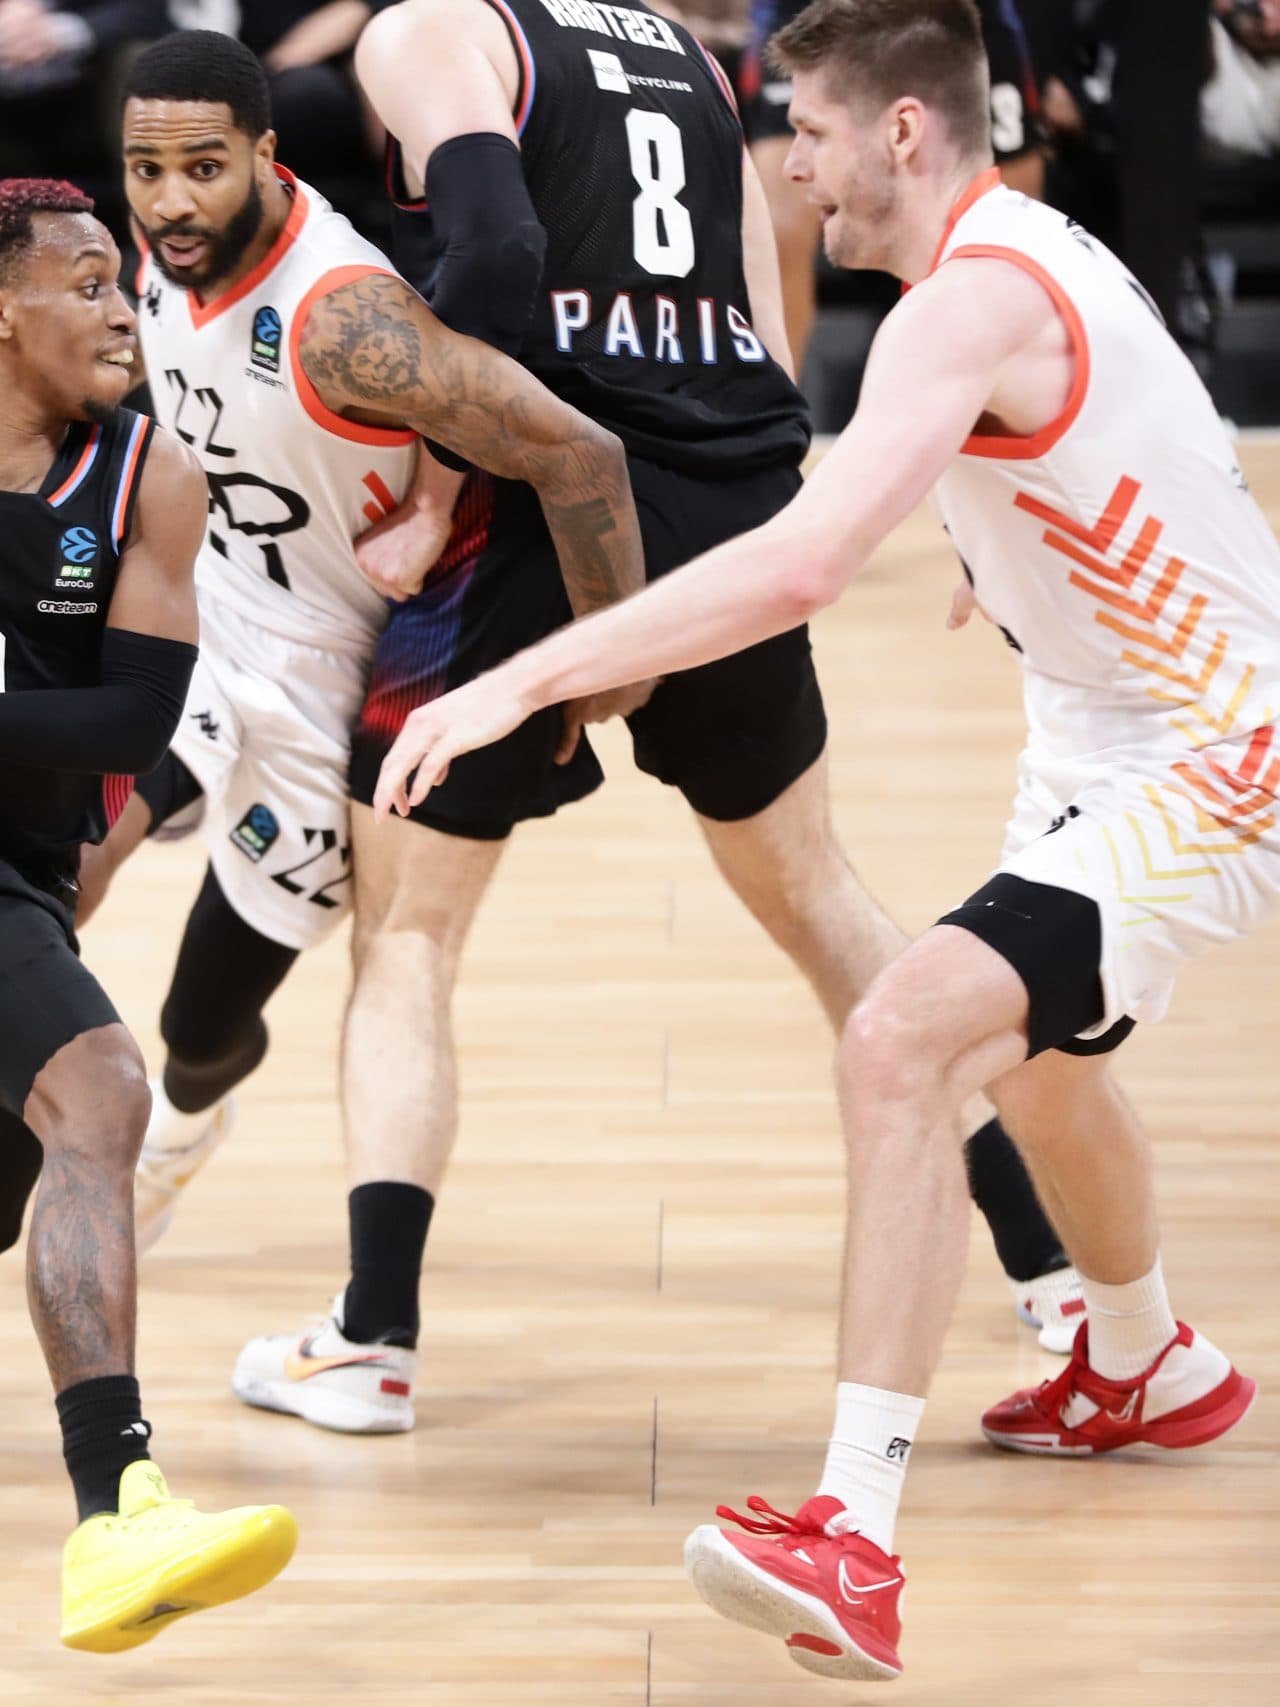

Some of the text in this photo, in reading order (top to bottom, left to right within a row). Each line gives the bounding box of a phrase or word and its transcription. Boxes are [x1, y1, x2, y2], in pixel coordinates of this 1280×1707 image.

[625, 108, 695, 278] 8
[550, 288, 767, 365] PARIS
[164, 369, 238, 458] 22
[37, 599, 98, 614] oneteam
[55, 578, 95, 590] EuroCup
